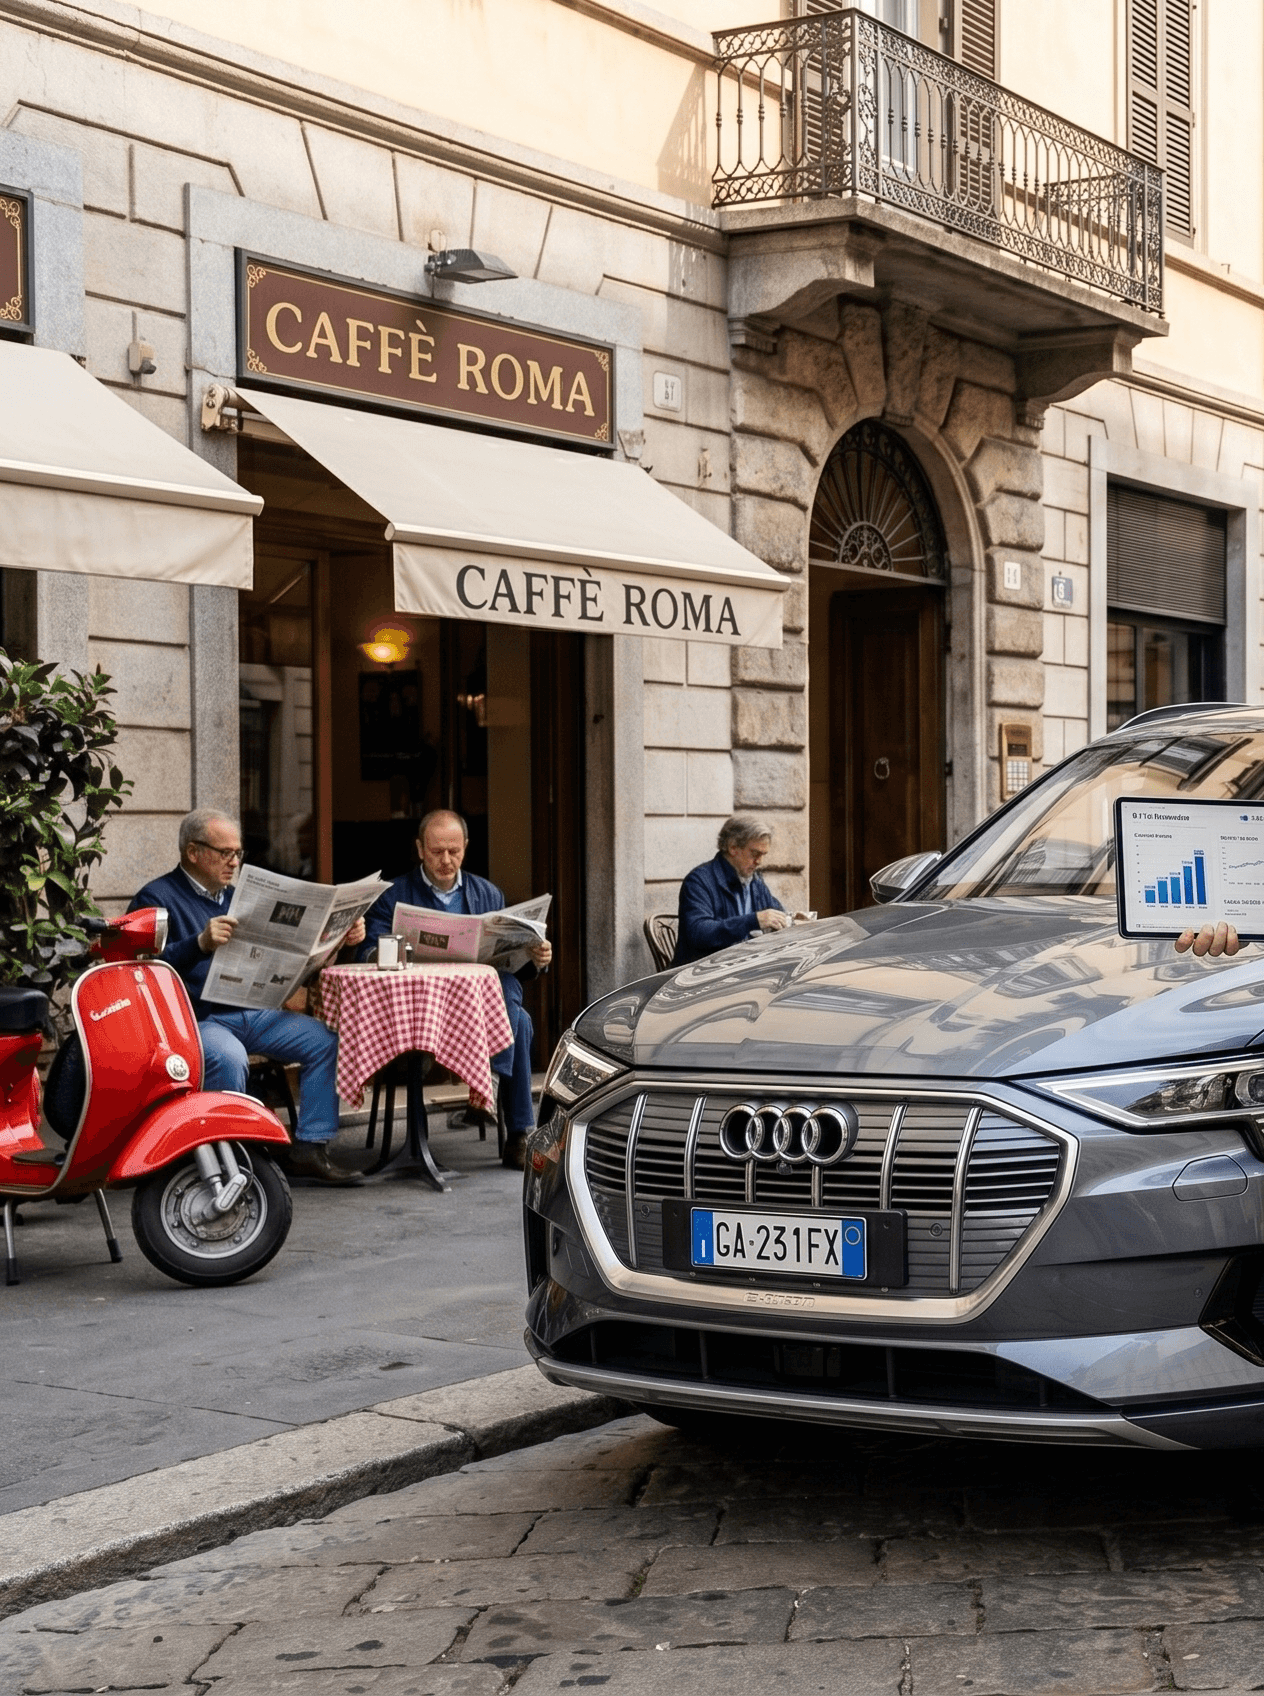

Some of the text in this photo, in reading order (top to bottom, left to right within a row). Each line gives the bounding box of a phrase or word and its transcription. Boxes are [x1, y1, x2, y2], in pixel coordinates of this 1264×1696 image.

[265, 301, 596, 417] CAFFÈ ROMA
[456, 564, 742, 636] CAFFÈ ROMA
